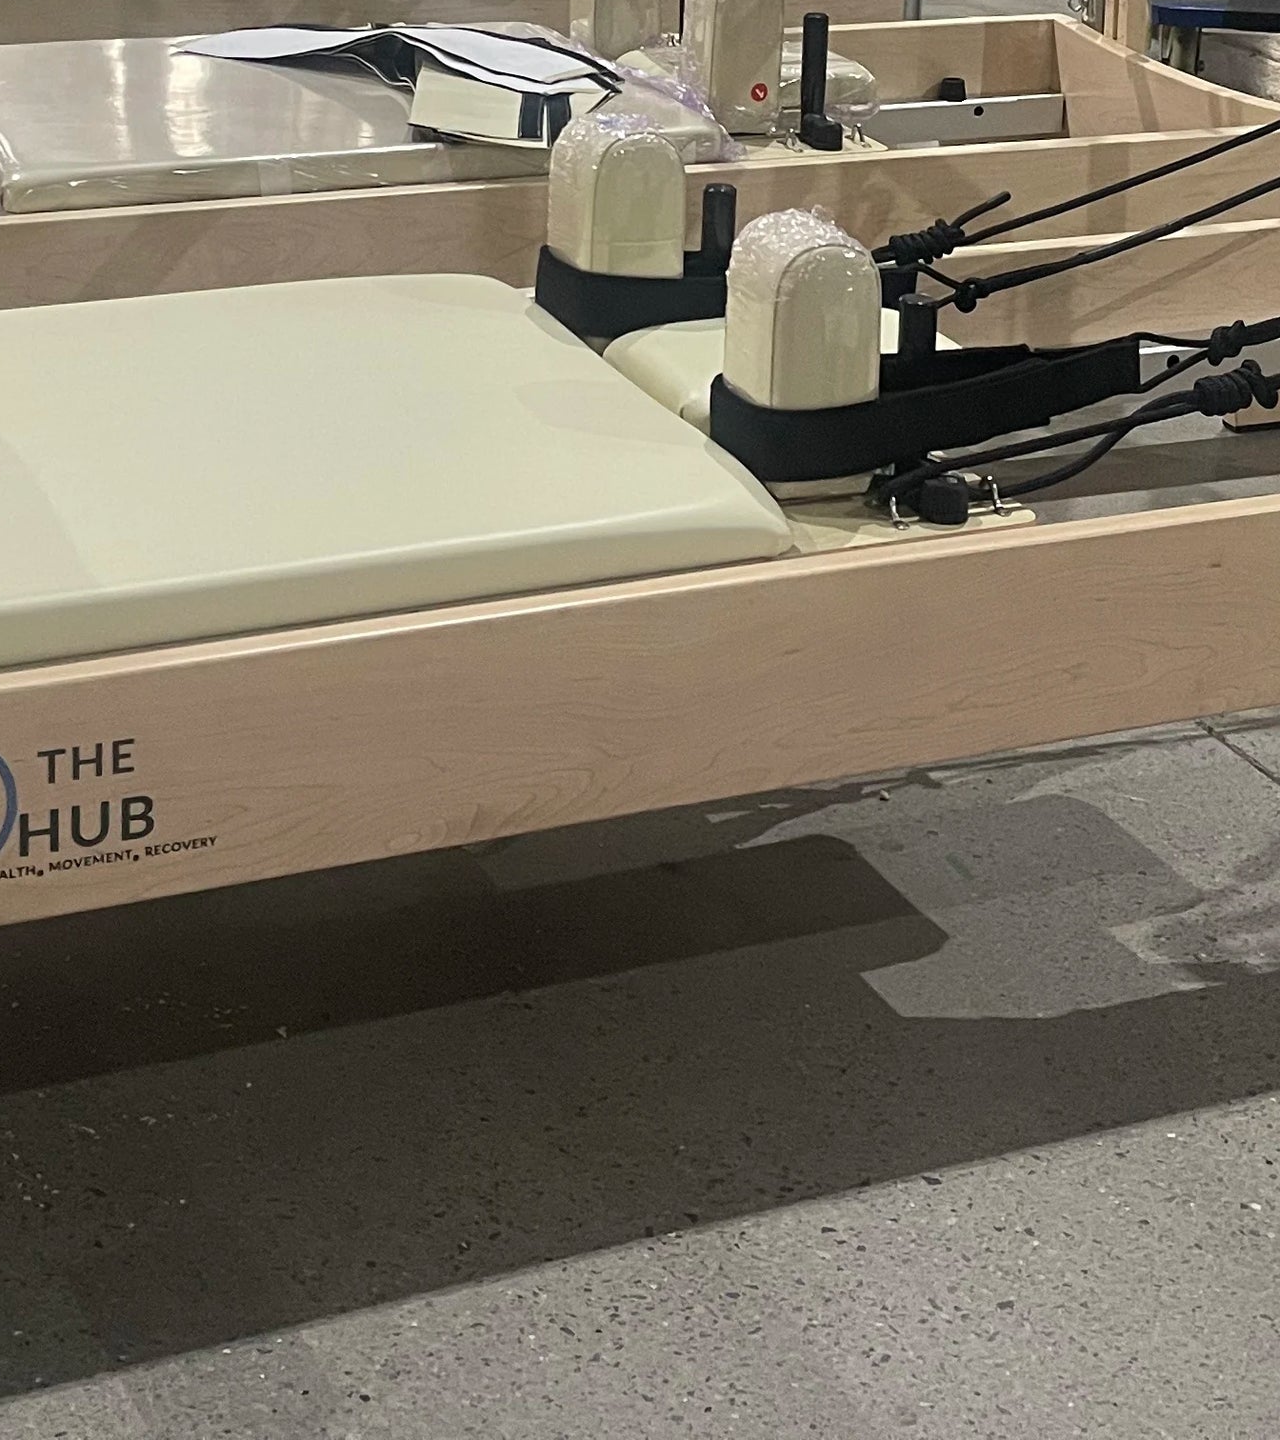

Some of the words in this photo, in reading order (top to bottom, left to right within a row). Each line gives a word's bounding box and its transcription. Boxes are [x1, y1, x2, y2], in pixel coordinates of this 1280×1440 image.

[37, 738, 135, 784] THE
[19, 795, 155, 858] HUB
[145, 836, 218, 857] RECOVERY
